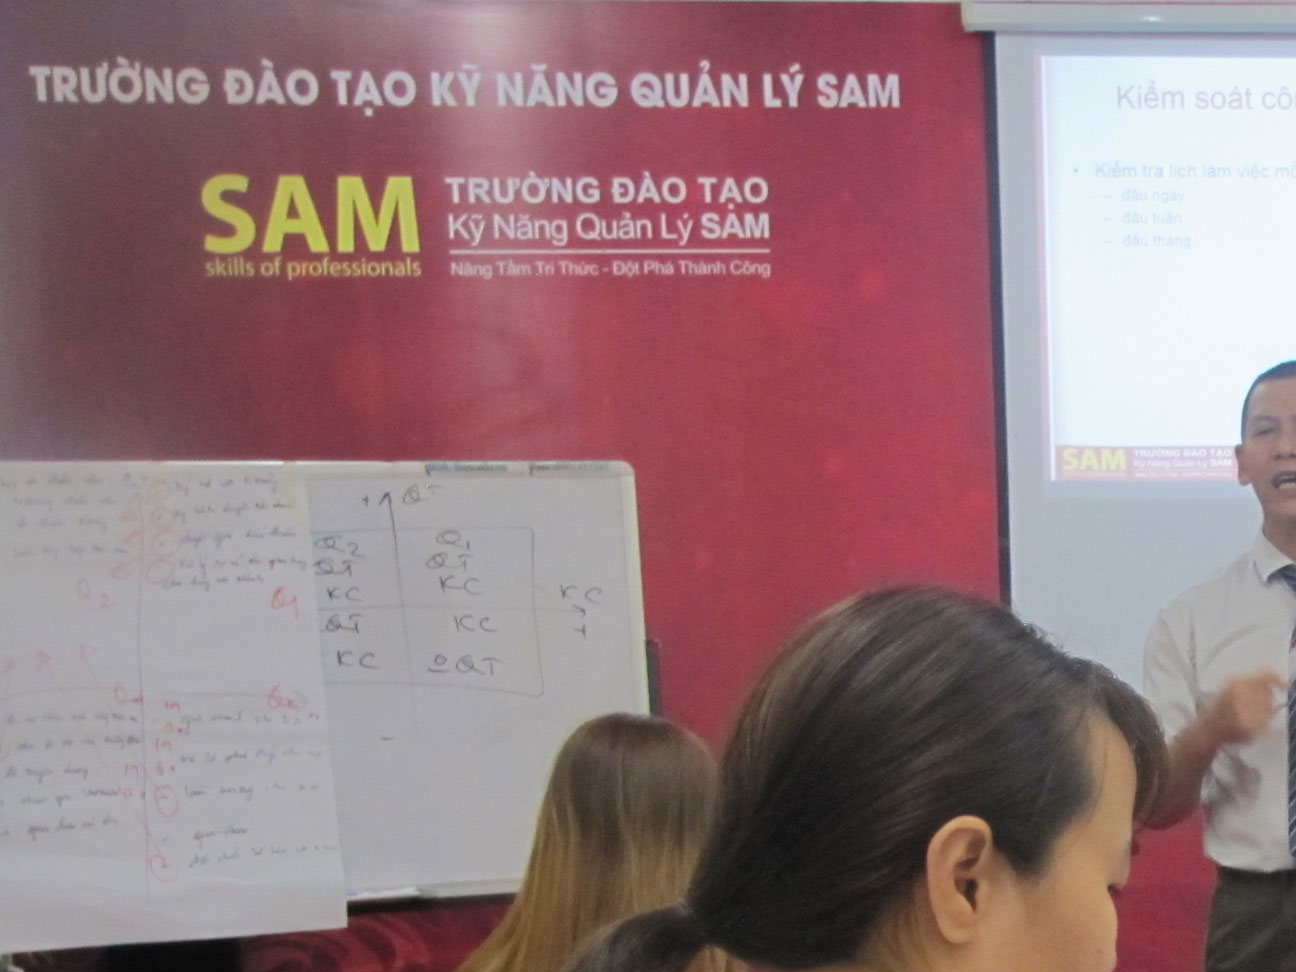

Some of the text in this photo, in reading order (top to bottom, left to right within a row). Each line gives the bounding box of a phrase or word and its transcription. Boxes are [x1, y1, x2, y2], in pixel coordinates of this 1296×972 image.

[29, 56, 900, 117] TRƯỜNG ĐÀO TẠO KỸ NĂNG QUẢN LÝ SAM
[1116, 80, 1185, 111] Kiểm
[1195, 85, 1253, 111] soát
[1142, 164, 1164, 178] tra
[445, 172, 769, 210] TRƯỜNG ĐÀO TẠO
[201, 174, 420, 254] SAM
[448, 212, 770, 246] Kỹ Năng Quản Lý SAM
[205, 257, 422, 281] skills of professionals
[1061, 448, 1127, 471] SAM
